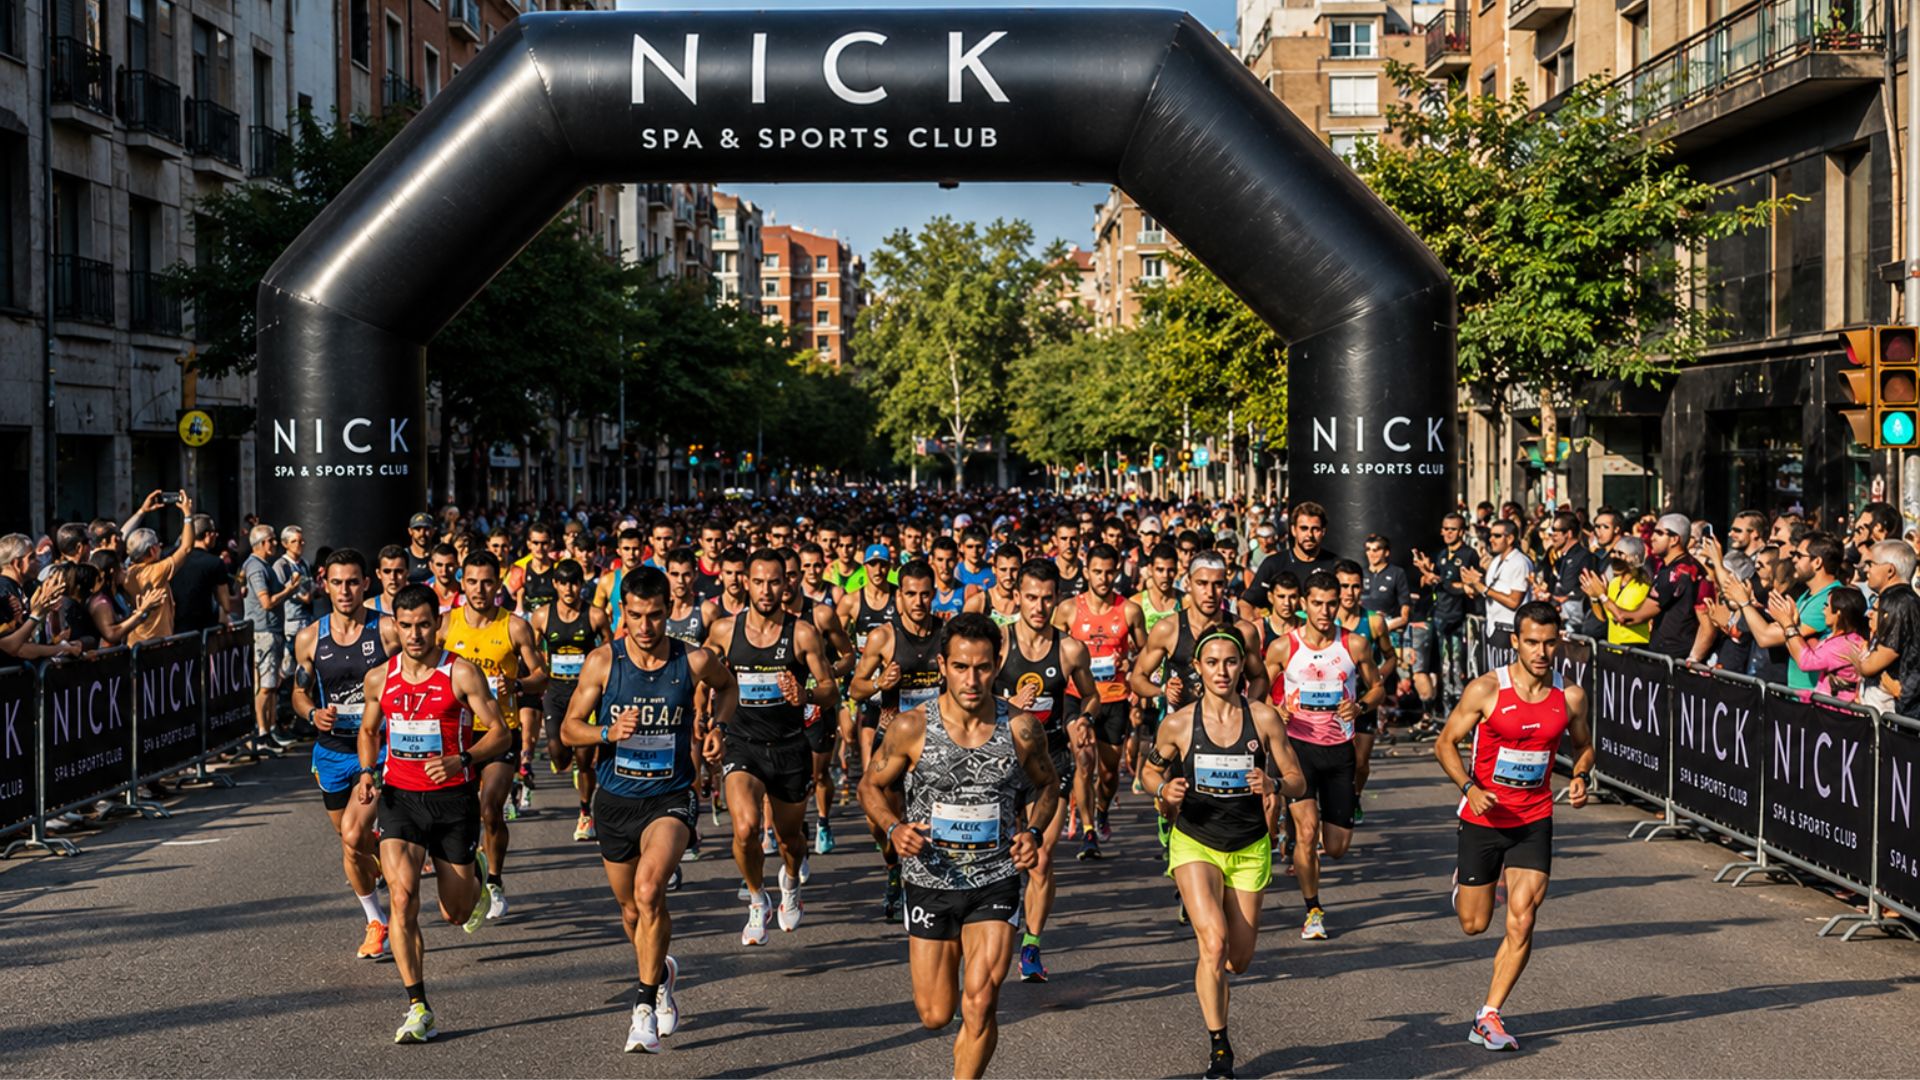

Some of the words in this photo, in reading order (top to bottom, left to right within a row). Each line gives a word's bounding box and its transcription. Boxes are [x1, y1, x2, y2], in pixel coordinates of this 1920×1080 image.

[631, 31, 1010, 105] NICK
[642, 128, 703, 149] SPA
[720, 128, 740, 149] &
[758, 127, 889, 149] SPORTS
[908, 127, 998, 149] CLUB
[274, 417, 409, 454] NICK
[1313, 416, 1444, 452] NICK
[274, 465, 295, 477] SPA
[300, 466, 309, 477] &
[316, 465, 373, 477] SPORTS
[379, 464, 409, 475] CLUB
[1313, 463, 1336, 474] SPA
[1341, 463, 1350, 474] &
[1356, 463, 1412, 474] SPORTS
[1418, 463, 1444, 474] CLUB
[143, 659, 195, 720] NICK
[210, 644, 251, 699] NICK
[54, 676, 122, 746] NICK
[1603, 669, 1660, 736] NICK
[1681, 692, 1749, 768] NICK
[1774, 720, 1859, 808] NICK
[1729, 786, 1747, 806] CLUB
[1773, 803, 1787, 823] SPA
[1798, 812, 1830, 839] SPORTS
[1834, 826, 1857, 849] CLUB
[1890, 849, 1907, 874] SPA
